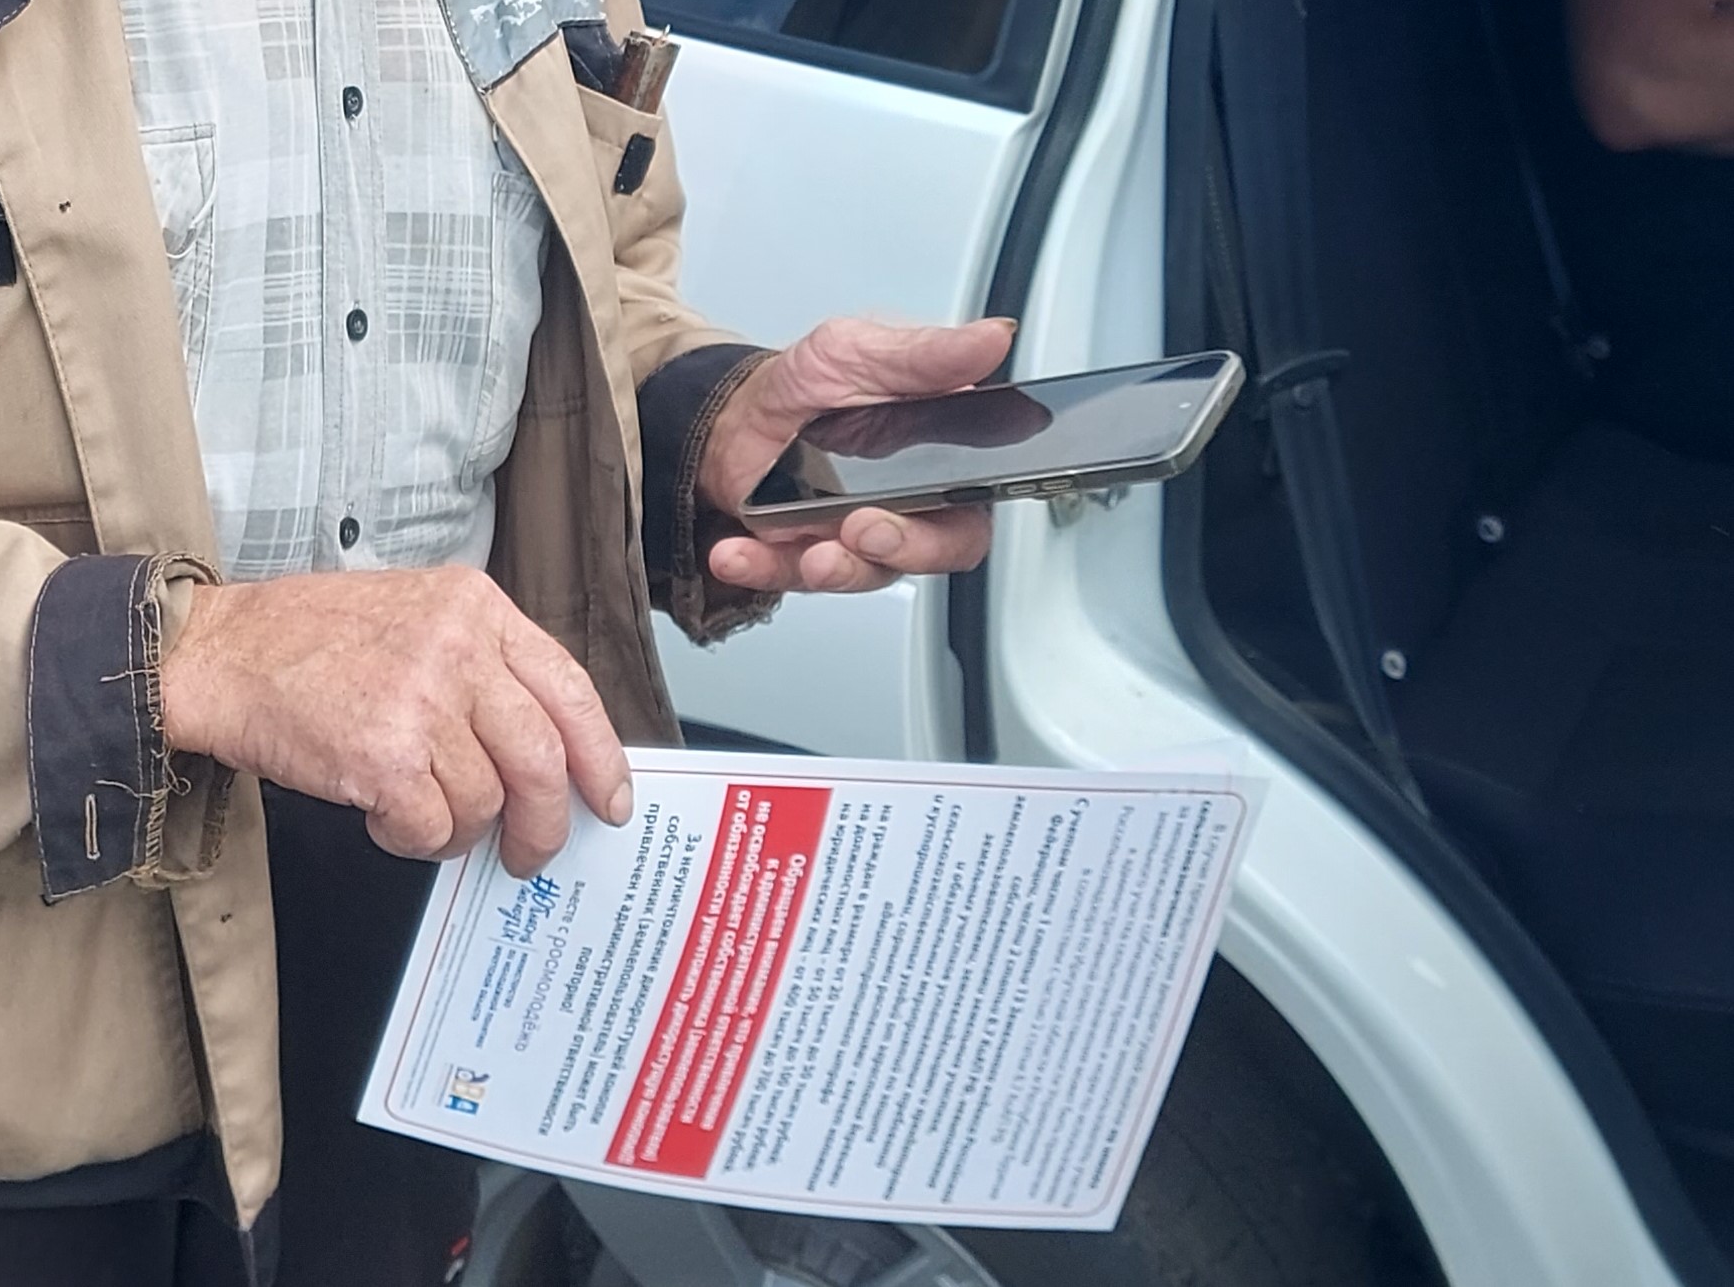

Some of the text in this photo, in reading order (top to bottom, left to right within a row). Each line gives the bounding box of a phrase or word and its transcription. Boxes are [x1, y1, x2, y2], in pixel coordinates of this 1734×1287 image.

[734, 788, 753, 810] от
[754, 800, 773, 824] не
[838, 801, 854, 821] на
[858, 803, 874, 822] на
[878, 804, 894, 823] на
[622, 802, 662, 891] привлечен
[641, 814, 684, 916] собственник
[683, 831, 704, 852] За
[705, 810, 750, 915] обязанности
[856, 824, 889, 889] граждан
[722, 823, 770, 930] освобождает
[641, 855, 694, 973] неуничтожение
[555, 945, 596, 1014] повторно!
[572, 903, 635, 1033] административной
[605, 973, 658, 1072] дикорастущей
